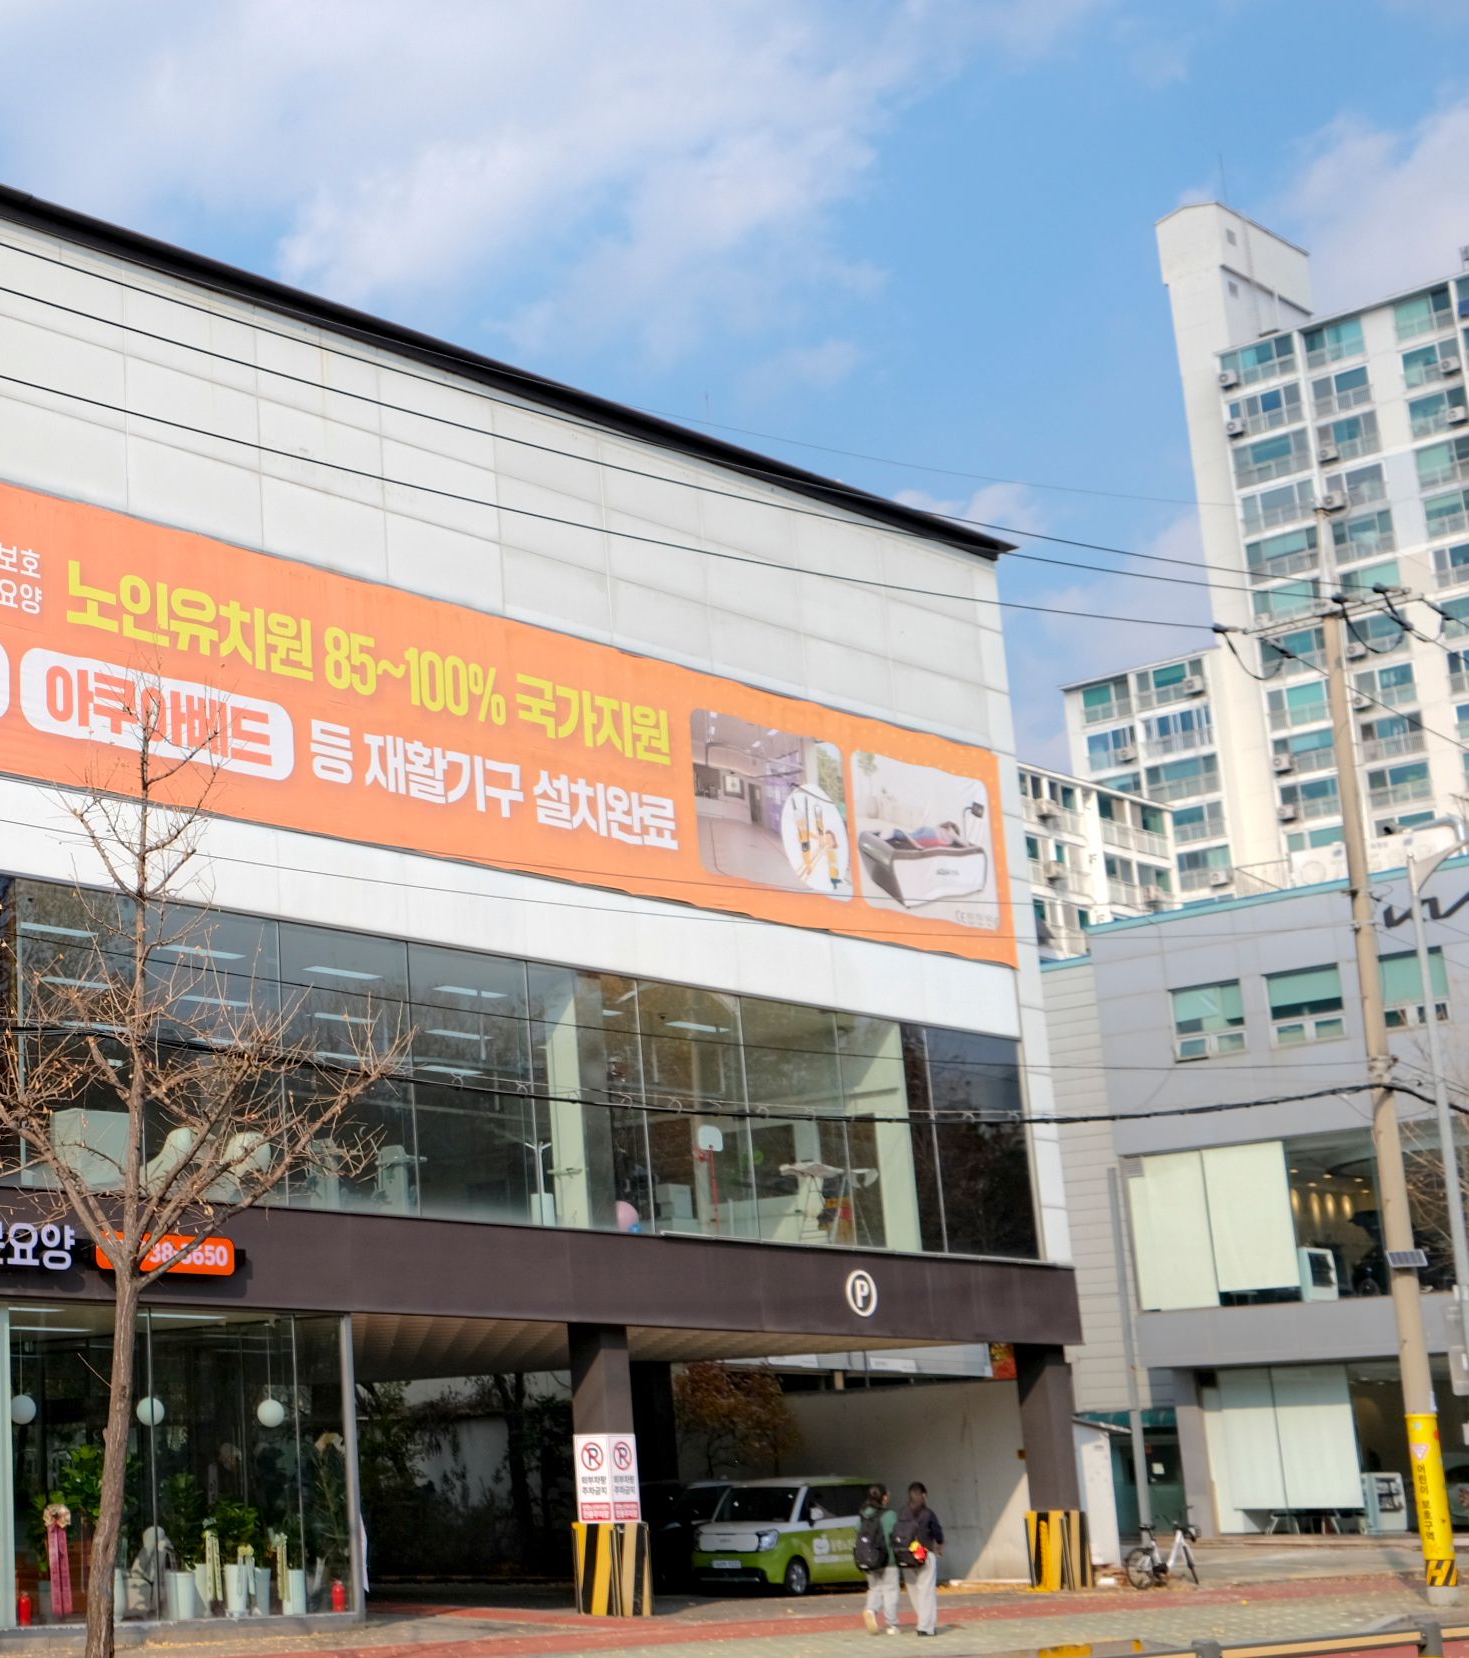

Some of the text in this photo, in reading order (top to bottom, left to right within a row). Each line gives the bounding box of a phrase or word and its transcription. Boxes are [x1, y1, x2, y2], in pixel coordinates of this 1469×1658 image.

[45, 665, 273, 768] 아쿠아베드
[66, 560, 671, 766] 노인유치원 85~100% 국가지원
[310, 719, 679, 851] 등 재활기구 설치완료
